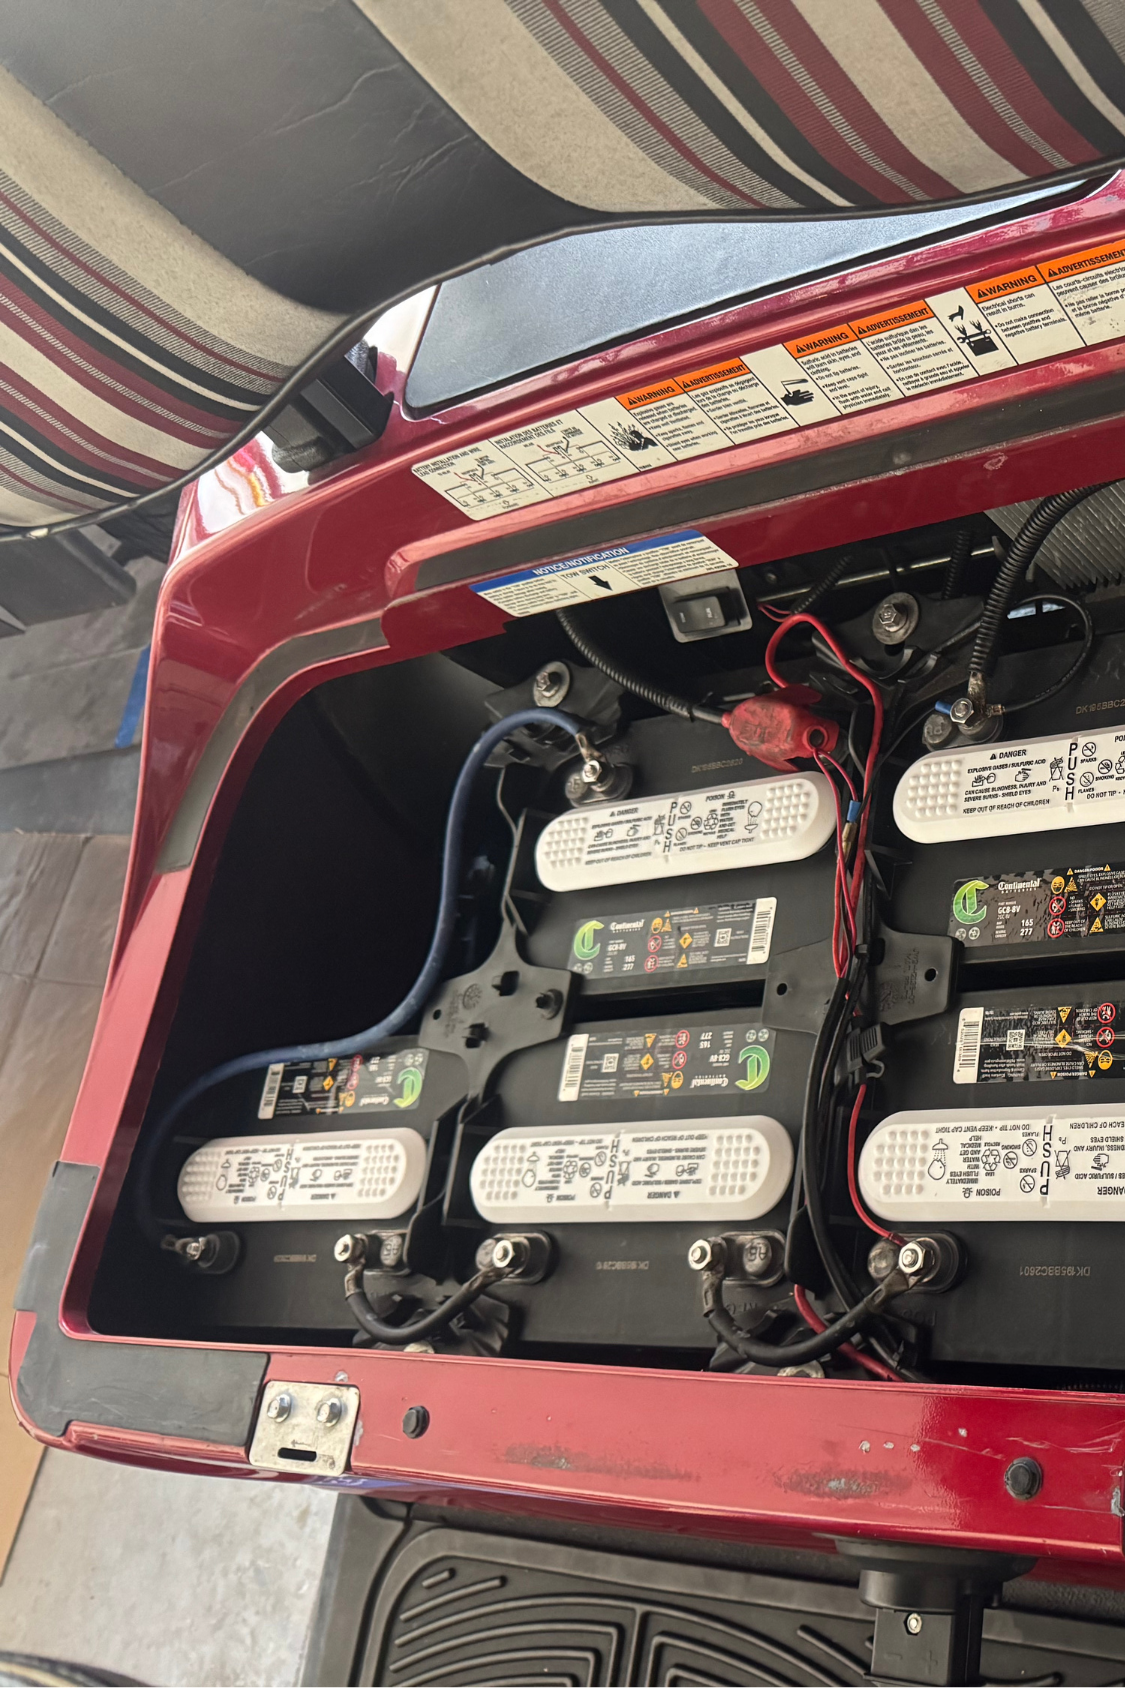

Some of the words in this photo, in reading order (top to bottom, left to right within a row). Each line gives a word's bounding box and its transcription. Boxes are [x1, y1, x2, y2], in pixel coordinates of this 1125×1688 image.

[985, 274, 1037, 294] WARNING
[866, 307, 928, 331] ADVERTISSEMENT
[803, 332, 848, 350] WARNING
[689, 364, 745, 385] ADVERTISSEMENT
[634, 386, 675, 402] WARNING
[532, 547, 630, 576] NOTICE/NOTIFICATION
[561, 571, 579, 580] TOW
[580, 564, 611, 575] SWITCH
[998, 749, 1026, 758] DANGER
[1064, 742, 1080, 800] PUSH
[997, 878, 1040, 890] Continental
[1021, 918, 1033, 926] 165
[1019, 927, 1032, 935] 277
[690, 1077, 728, 1087] Continental
[1039, 1124, 1052, 1195] PUSH
